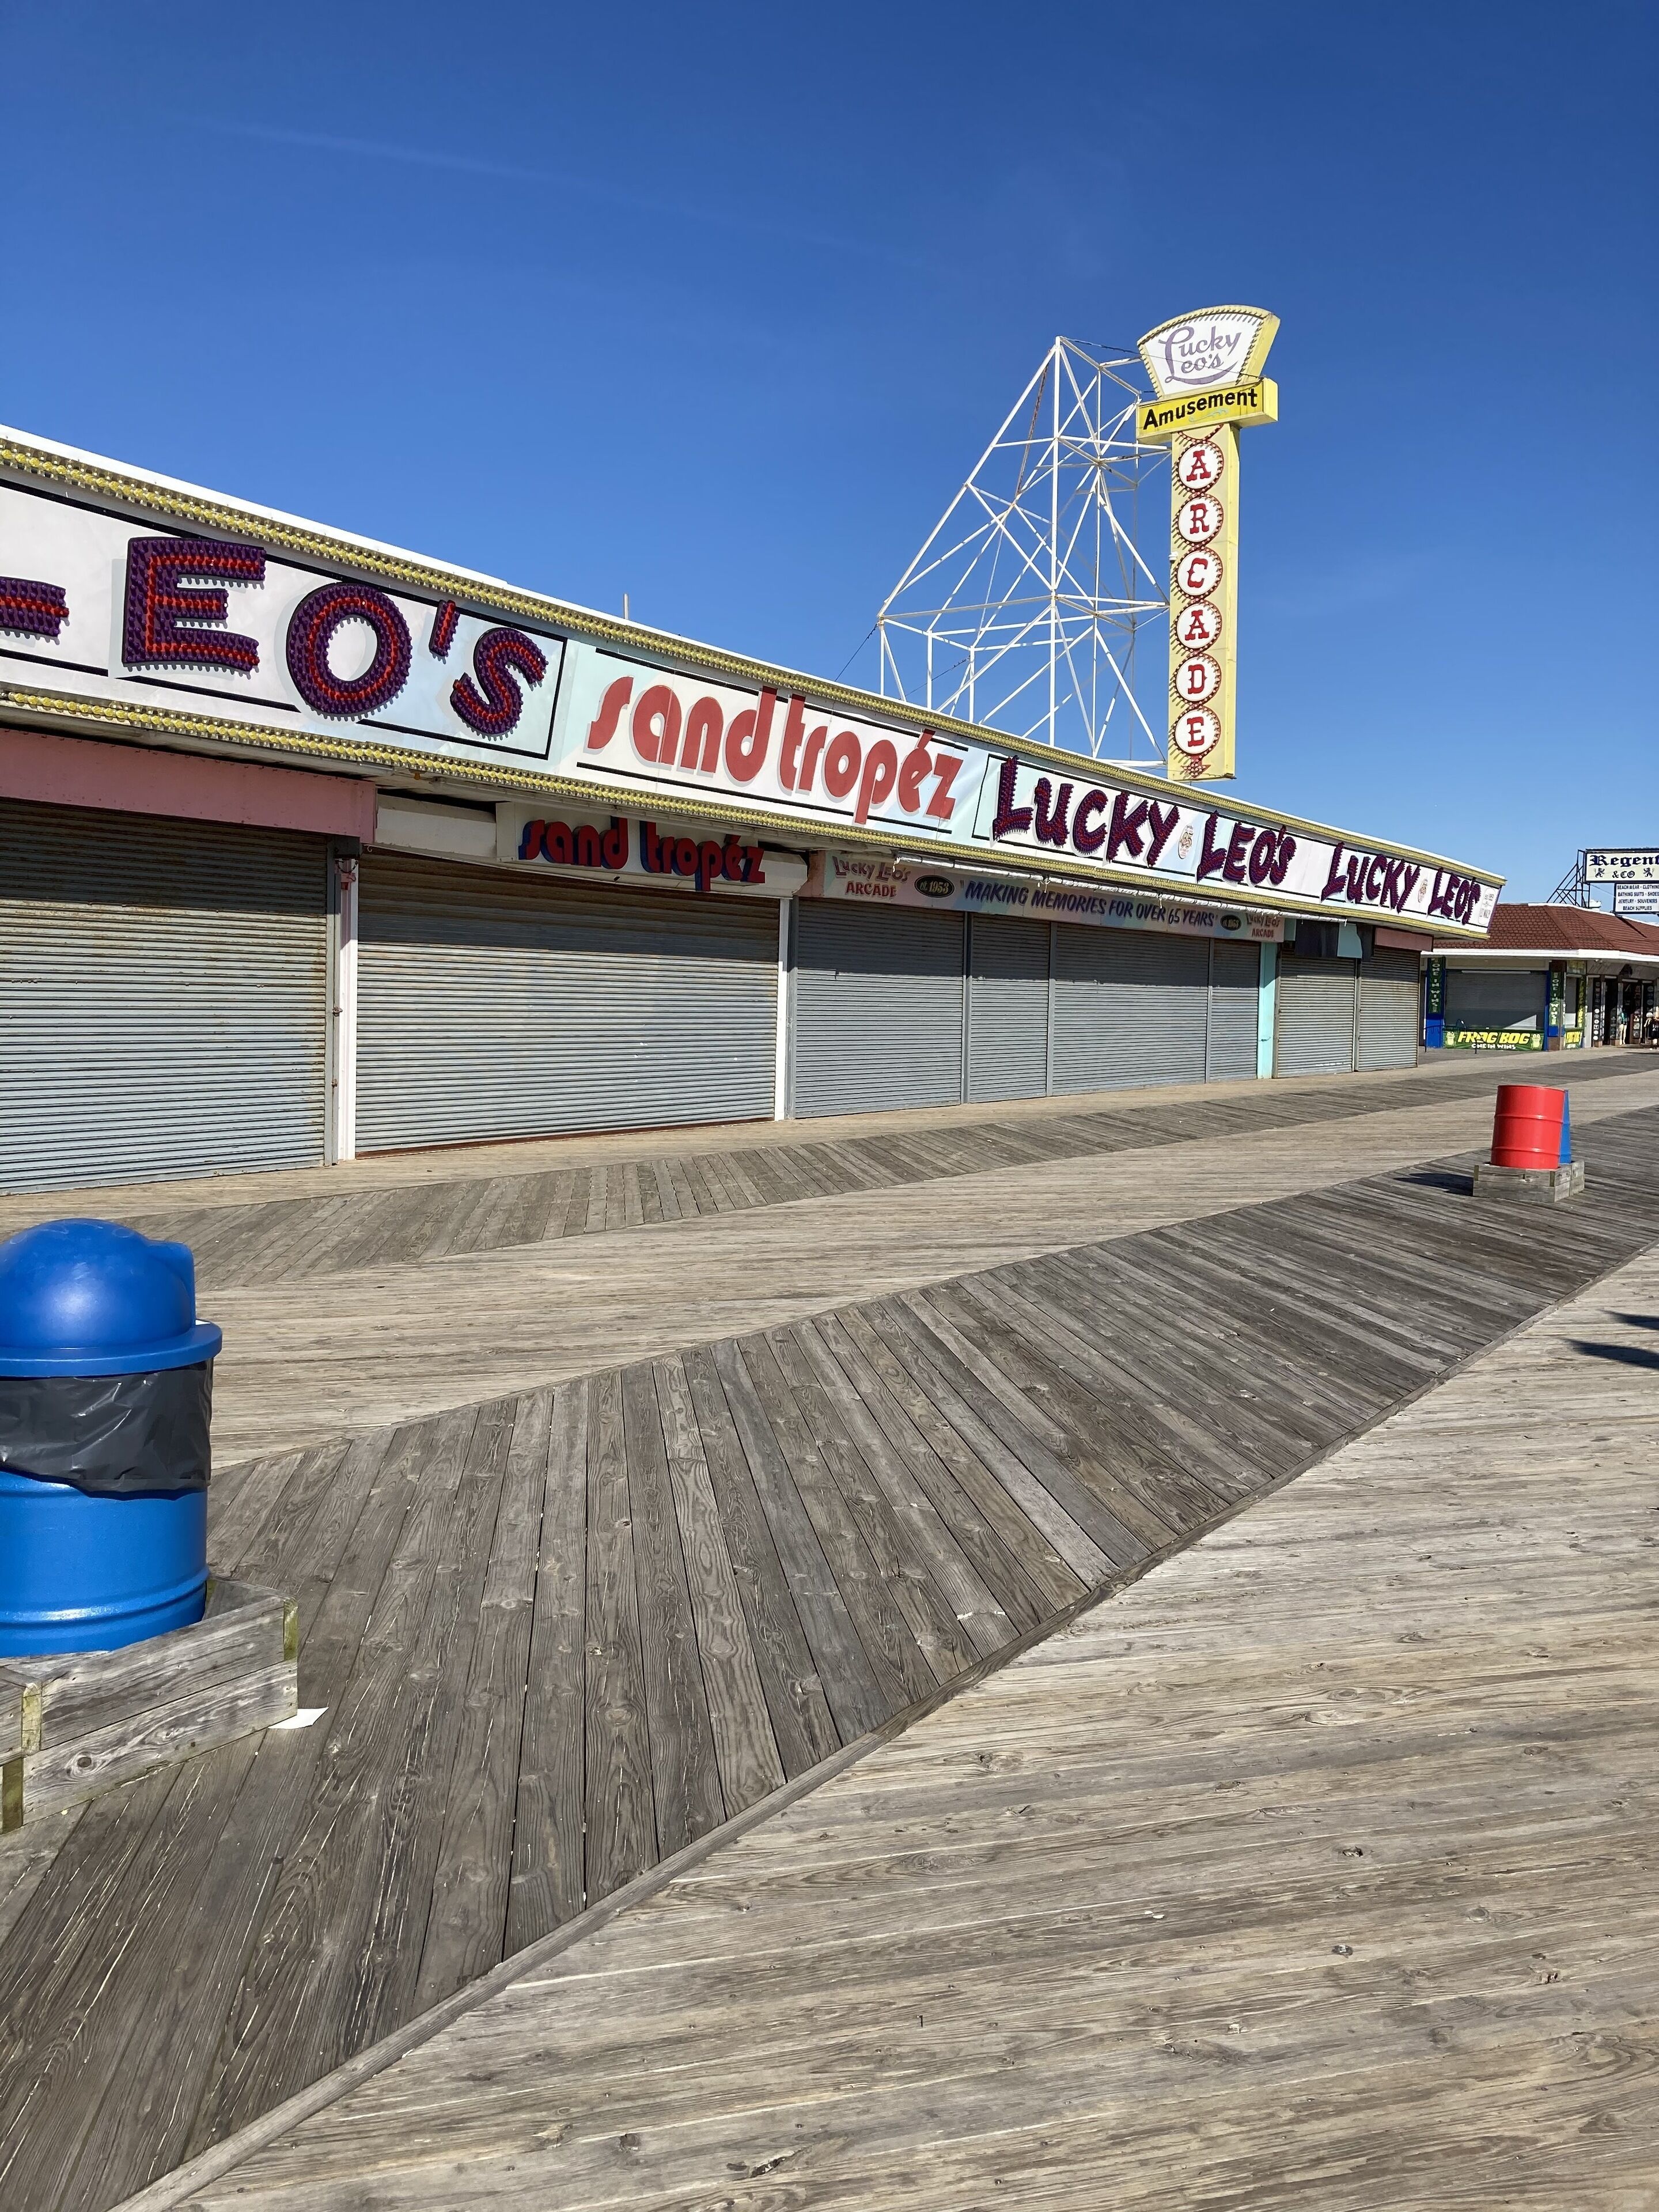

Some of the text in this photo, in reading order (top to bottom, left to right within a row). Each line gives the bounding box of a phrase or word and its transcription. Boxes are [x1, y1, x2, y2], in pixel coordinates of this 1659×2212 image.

[1158, 325, 1242, 378] Lucky
[1142, 388, 1258, 430] Amusement
[1185, 449, 1211, 748] ARCADE
[587, 676, 778, 782] sand
[518, 815, 629, 870] sand
[1196, 810, 1297, 886] LEO'S
[846, 880, 897, 898] ARCADE
[929, 880, 949, 894] 1953
[1031, 890, 1107, 915] MEMORIES
[1109, 899, 1134, 918] FOR
[1136, 903, 1166, 922] OVER
[1168, 908, 1180, 925] 65
[1264, 915, 1281, 927] LEOS
[1457, 1031, 1531, 1044] FROG BOG
